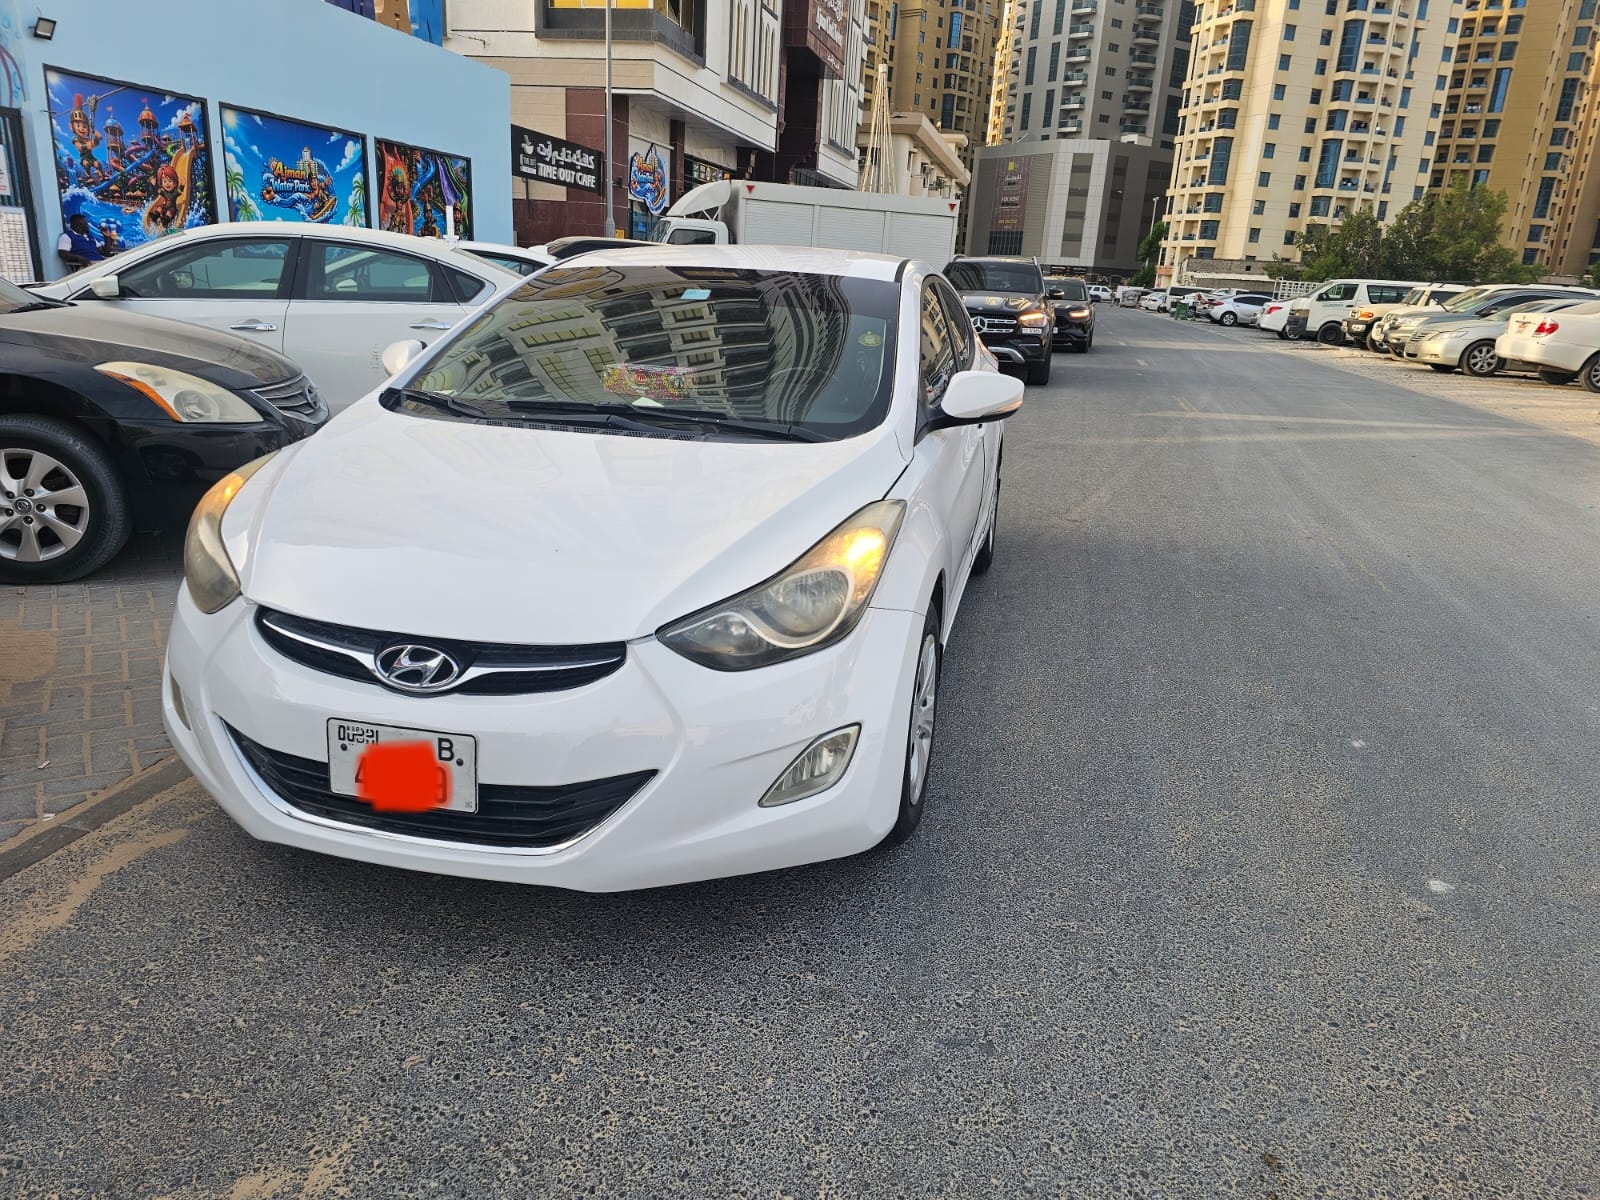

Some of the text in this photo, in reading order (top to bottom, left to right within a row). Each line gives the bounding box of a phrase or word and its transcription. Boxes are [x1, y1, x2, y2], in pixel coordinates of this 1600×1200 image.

[274, 162, 306, 180] Ajman
[537, 163, 558, 179] TIME
[558, 168, 576, 183] OUT
[576, 172, 596, 188] CAFE
[270, 178, 310, 192] Water Park
[438, 738, 455, 762] B
